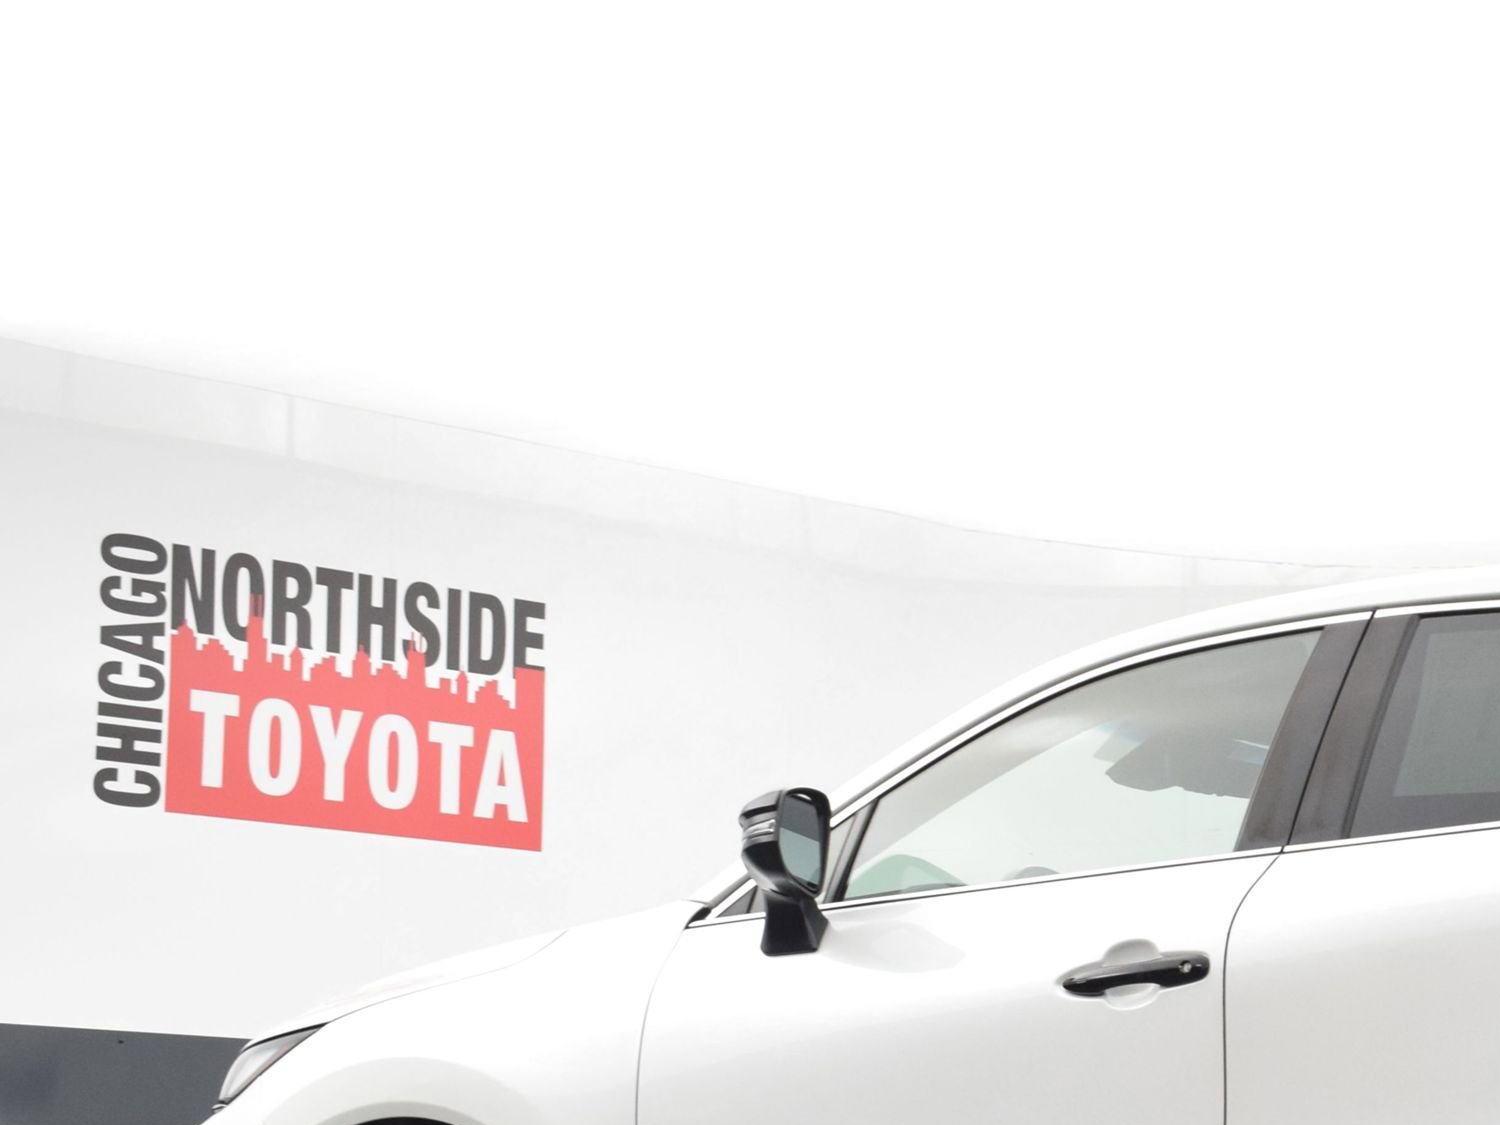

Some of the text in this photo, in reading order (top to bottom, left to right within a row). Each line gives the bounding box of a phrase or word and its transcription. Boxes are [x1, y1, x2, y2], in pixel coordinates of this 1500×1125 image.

[93, 532, 168, 808] CHICAGO
[170, 543, 546, 675] NORTHSIDE
[189, 689, 528, 823] TOYOTA
